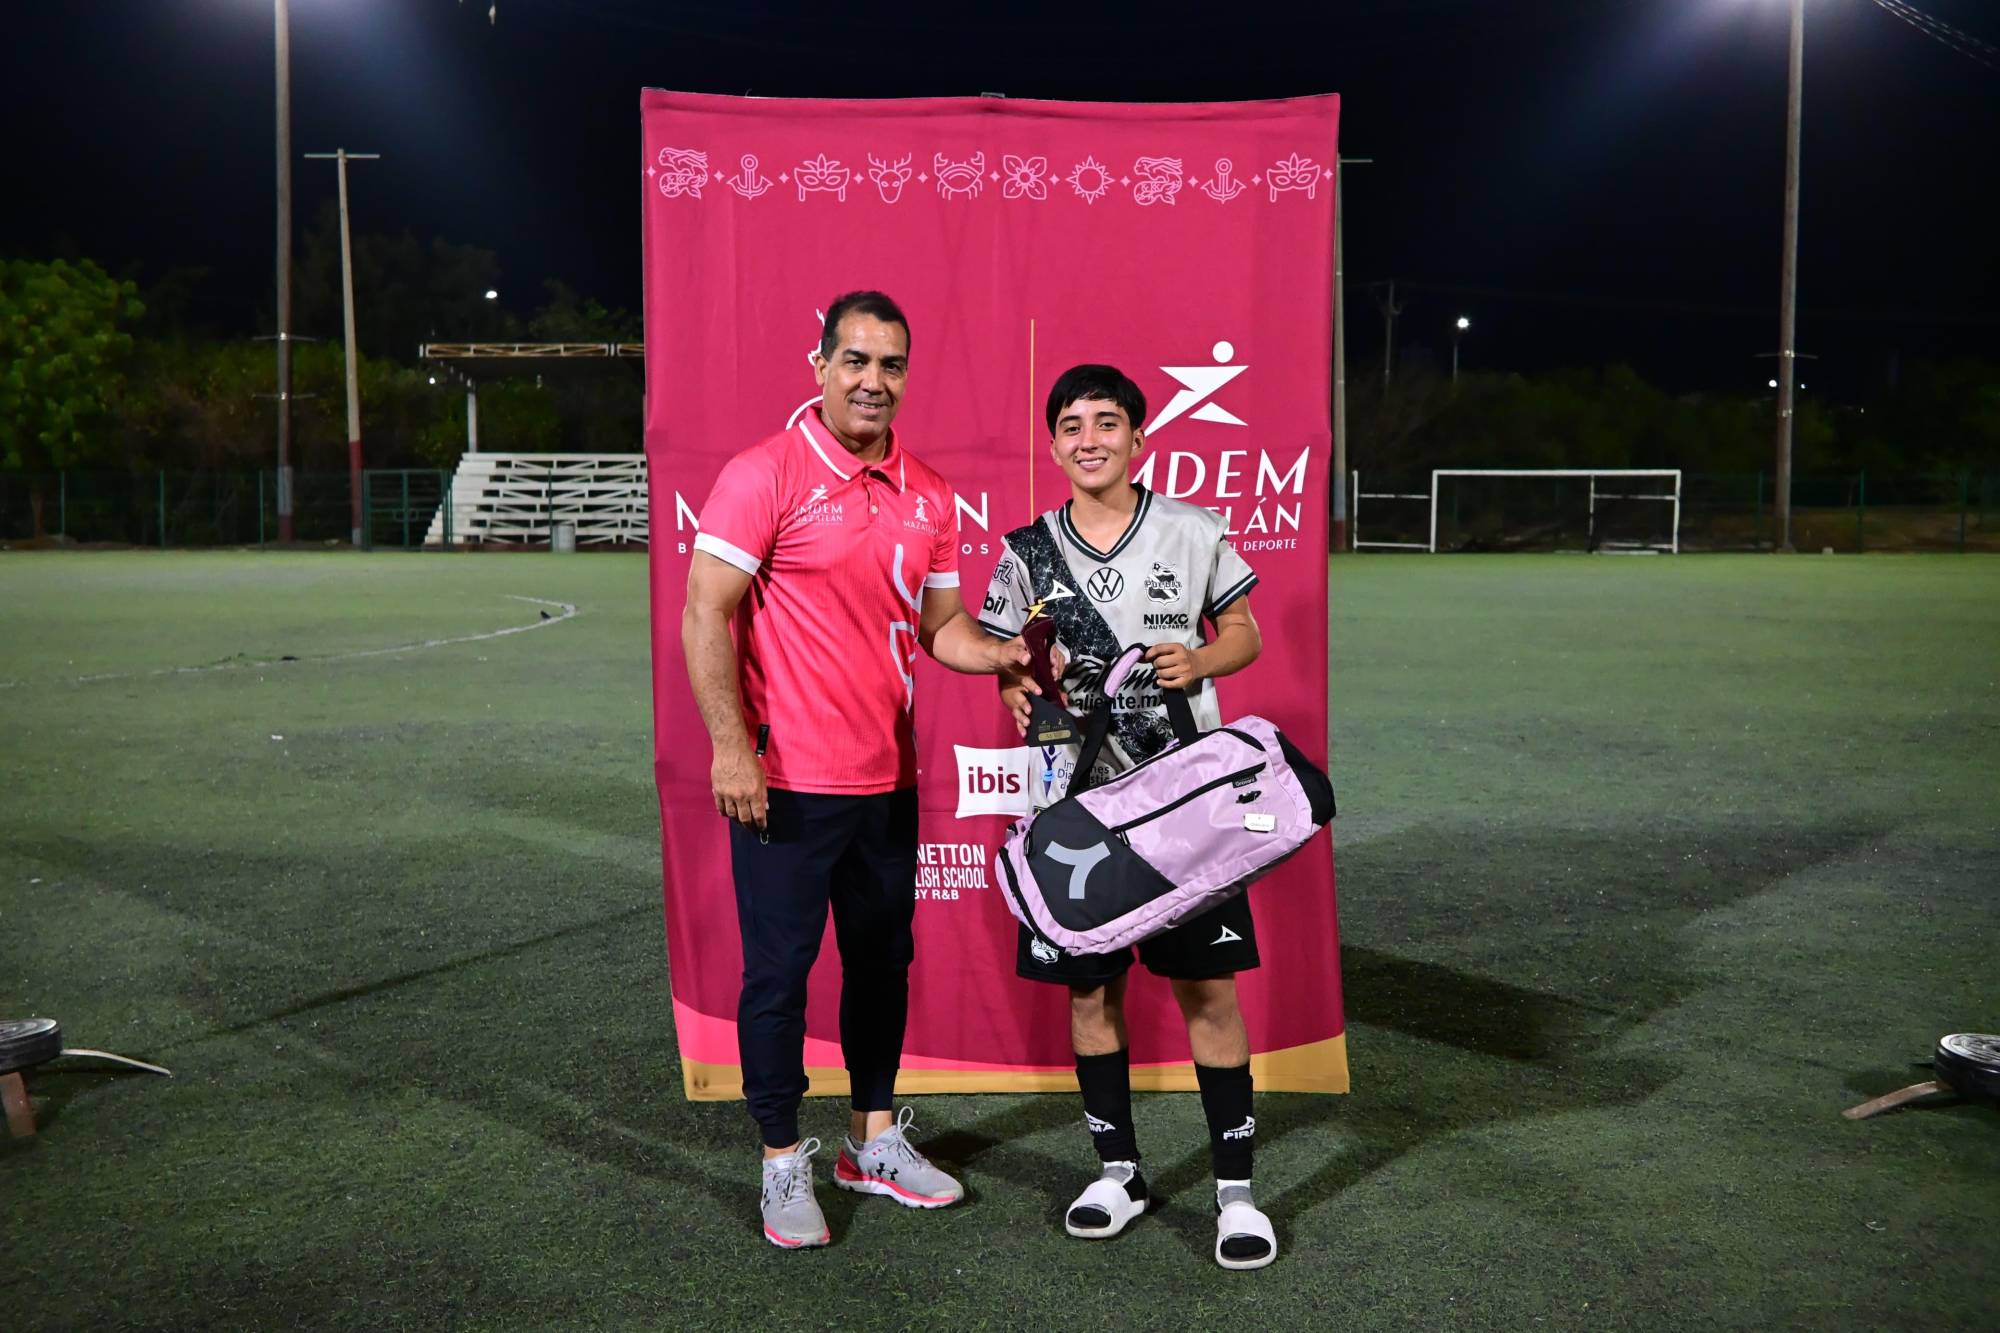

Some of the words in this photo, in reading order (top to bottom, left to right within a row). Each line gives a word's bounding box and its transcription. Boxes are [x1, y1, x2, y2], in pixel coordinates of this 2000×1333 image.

[1243, 538, 1297, 552] DEPORTE
[968, 765, 1021, 794] ibis
[942, 867, 989, 889] SCHOOL
[931, 889, 959, 900] R&B
